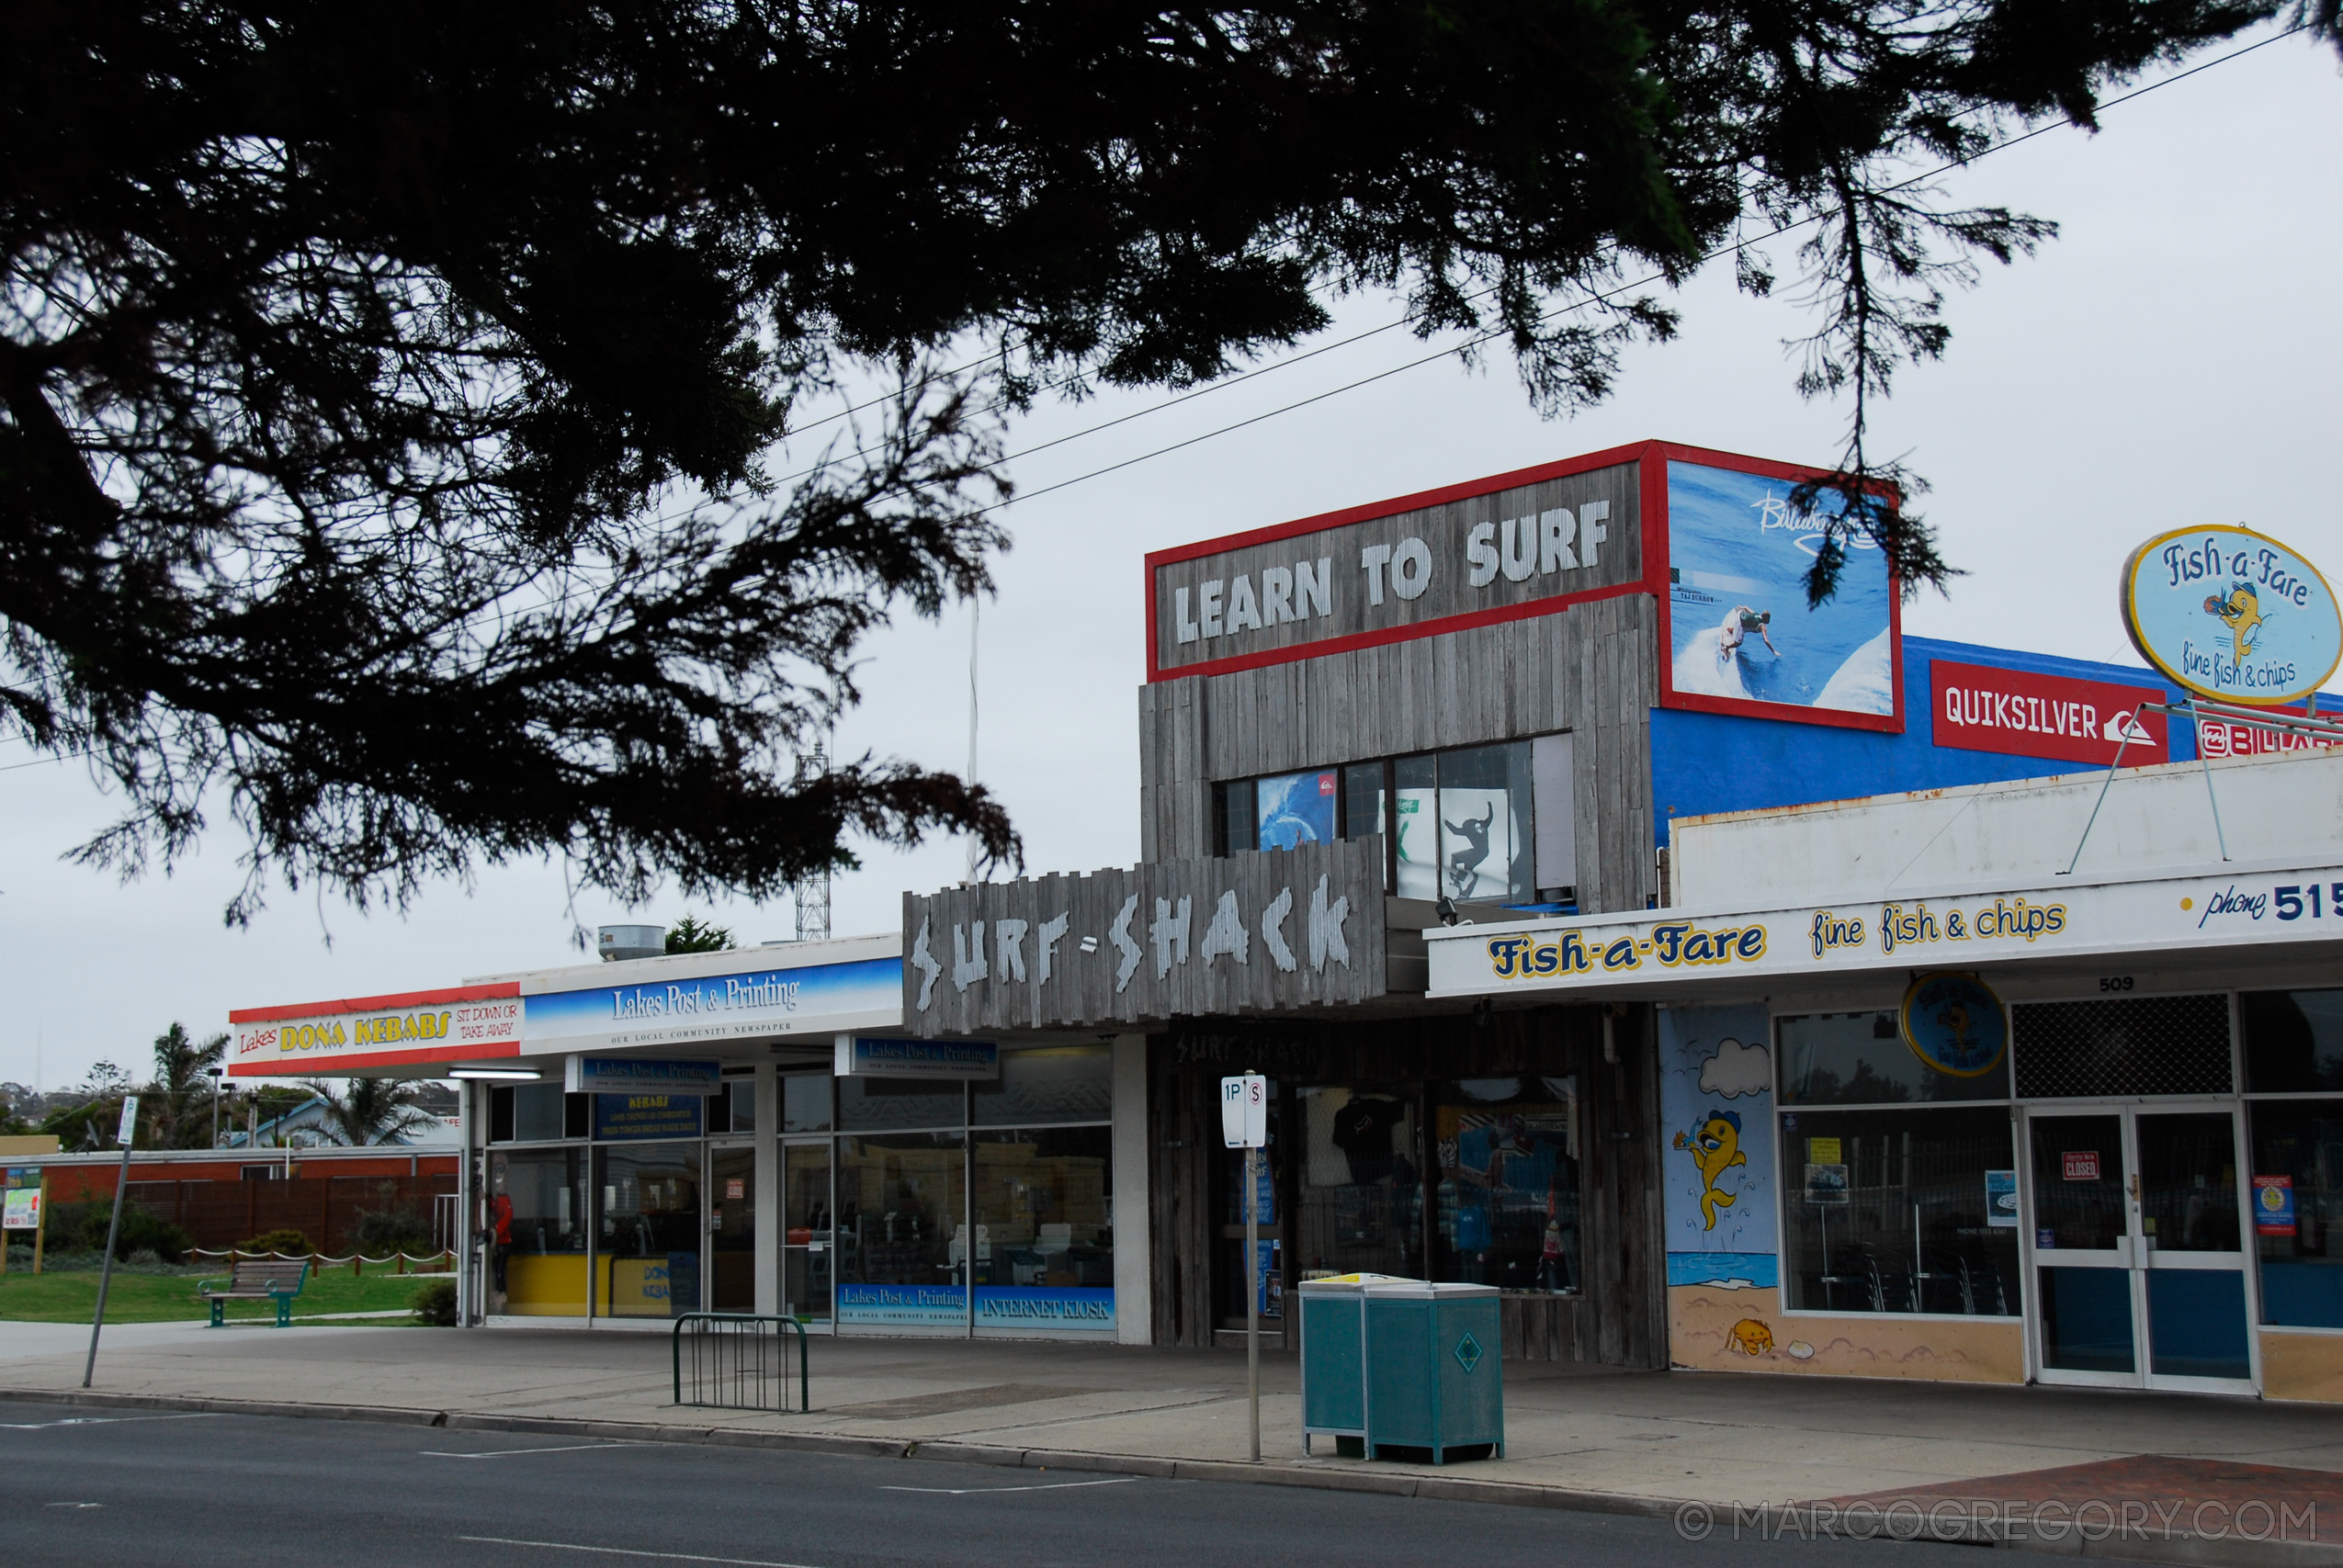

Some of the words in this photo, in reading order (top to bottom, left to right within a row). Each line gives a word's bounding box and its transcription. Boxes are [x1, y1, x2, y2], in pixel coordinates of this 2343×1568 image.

[1175, 557, 1332, 644] LEARN
[1362, 537, 1432, 606] TO
[1466, 500, 1610, 588] SURF
[2182, 640, 2211, 677] fine
[2213, 652, 2241, 689] fish
[2245, 671, 2257, 687] &
[2258, 660, 2295, 692] chips
[1945, 686, 2098, 739] QUIKSILVER
[2198, 885, 2267, 929] phone
[1809, 910, 1865, 960] fine
[1879, 903, 1941, 955] fish
[1945, 910, 1972, 941] &
[1974, 897, 2067, 944] chips
[1487, 922, 1768, 979] Fish-a-Fare
[2100, 976, 2134, 993] 509
[613, 988, 662, 1021] Lakes
[665, 985, 702, 1016] Post
[707, 988, 719, 1011] &
[724, 975, 800, 1011] Printing
[457, 1009, 471, 1022] SIT
[473, 1006, 502, 1021] DOWN
[504, 1005, 517, 1018] OR
[240, 1028, 277, 1054] Lakes
[280, 1021, 347, 1052] DONA
[355, 1011, 451, 1045] KEBABS
[460, 1025, 483, 1039] TAKE
[486, 1022, 514, 1037] AWAY
[611, 1035, 628, 1044] OUR
[635, 1032, 664, 1042] LOCAL
[670, 1027, 727, 1039] COMMUNITY
[735, 1022, 791, 1033] NEWSPAPER
[868, 1043, 902, 1057] Lakes
[905, 1043, 928, 1058] Post
[943, 1044, 988, 1064] Printing
[595, 1062, 628, 1076] Lakes
[632, 1063, 653, 1077] Post
[668, 1065, 713, 1081] Printing
[628, 1095, 669, 1109] KEBABS
[1226, 1084, 1240, 1100] 1P
[2066, 1162, 2096, 1176] CLOSED
[643, 1285, 670, 1299] KEBA
[843, 1288, 877, 1305] Lakes
[878, 1288, 902, 1305] Post
[905, 1295, 912, 1304] &
[918, 1289, 965, 1309] Printing
[982, 1299, 1059, 1319] INTERNET
[1062, 1301, 1109, 1320] KIOSK
